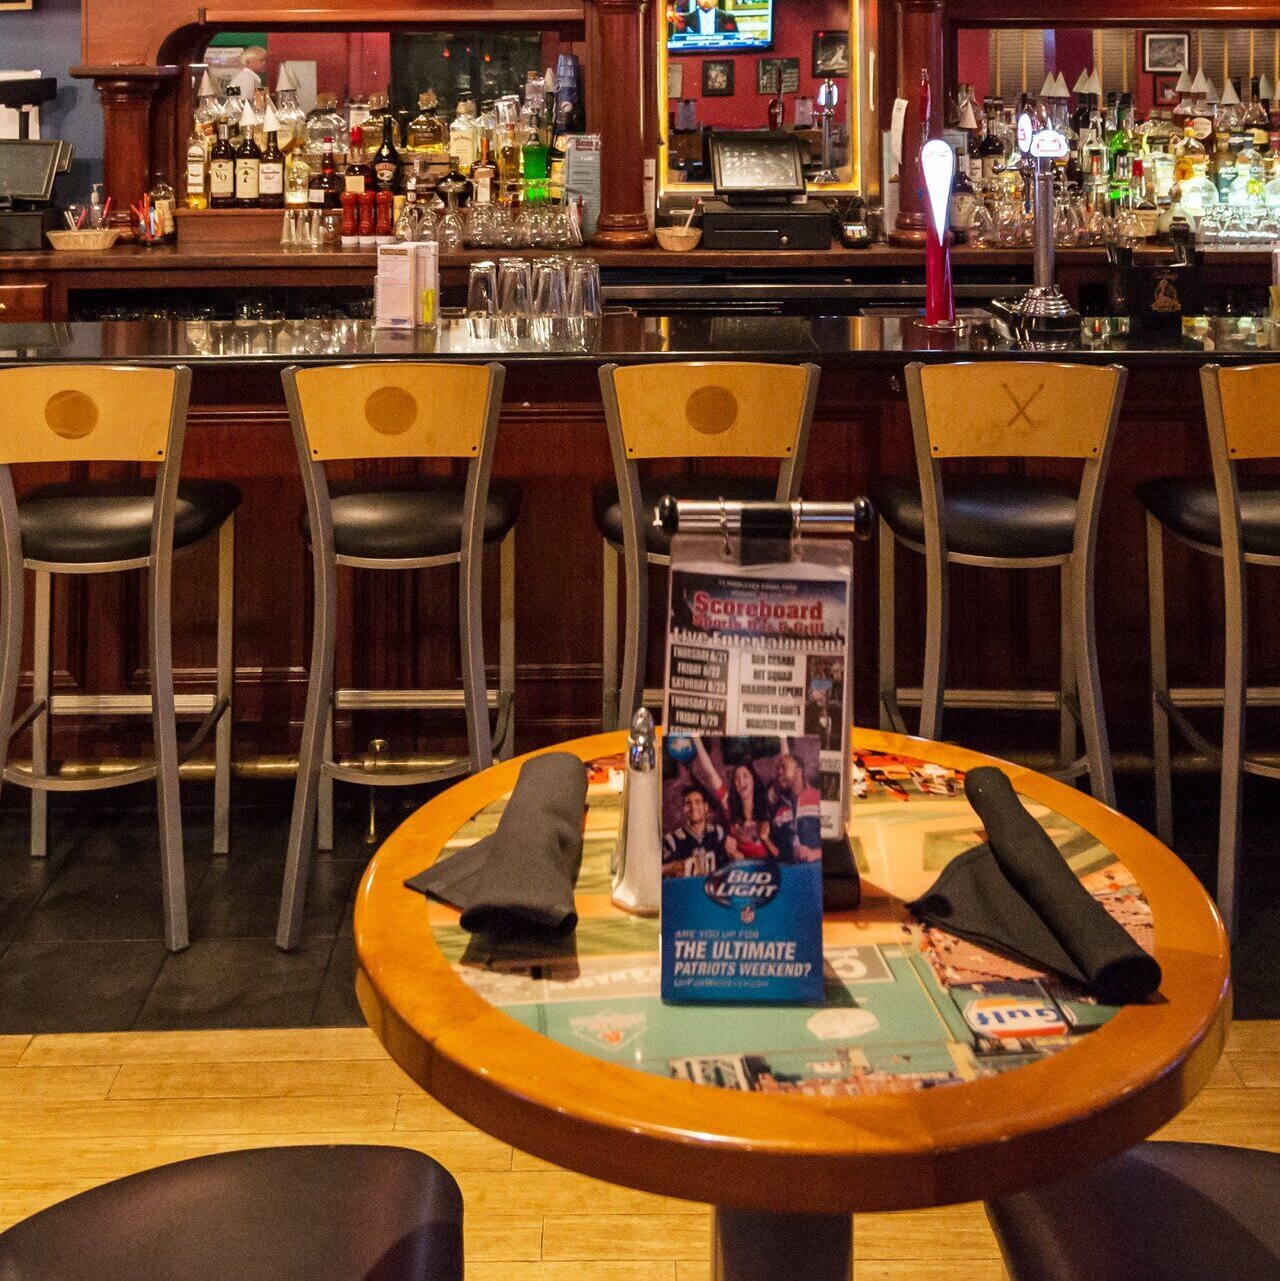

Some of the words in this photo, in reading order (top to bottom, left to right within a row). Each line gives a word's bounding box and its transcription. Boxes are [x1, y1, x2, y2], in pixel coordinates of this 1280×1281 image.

[693, 590, 824, 620] Scoreboard
[727, 869, 772, 884] BUD
[716, 884, 778, 898] LIGHT
[674, 940, 708, 960] THE
[712, 941, 797, 961] ULTIMATE
[674, 961, 737, 976] PATRIOTS
[739, 962, 812, 977] WEEKEND?
[974, 1006, 1064, 1026] Gulf
